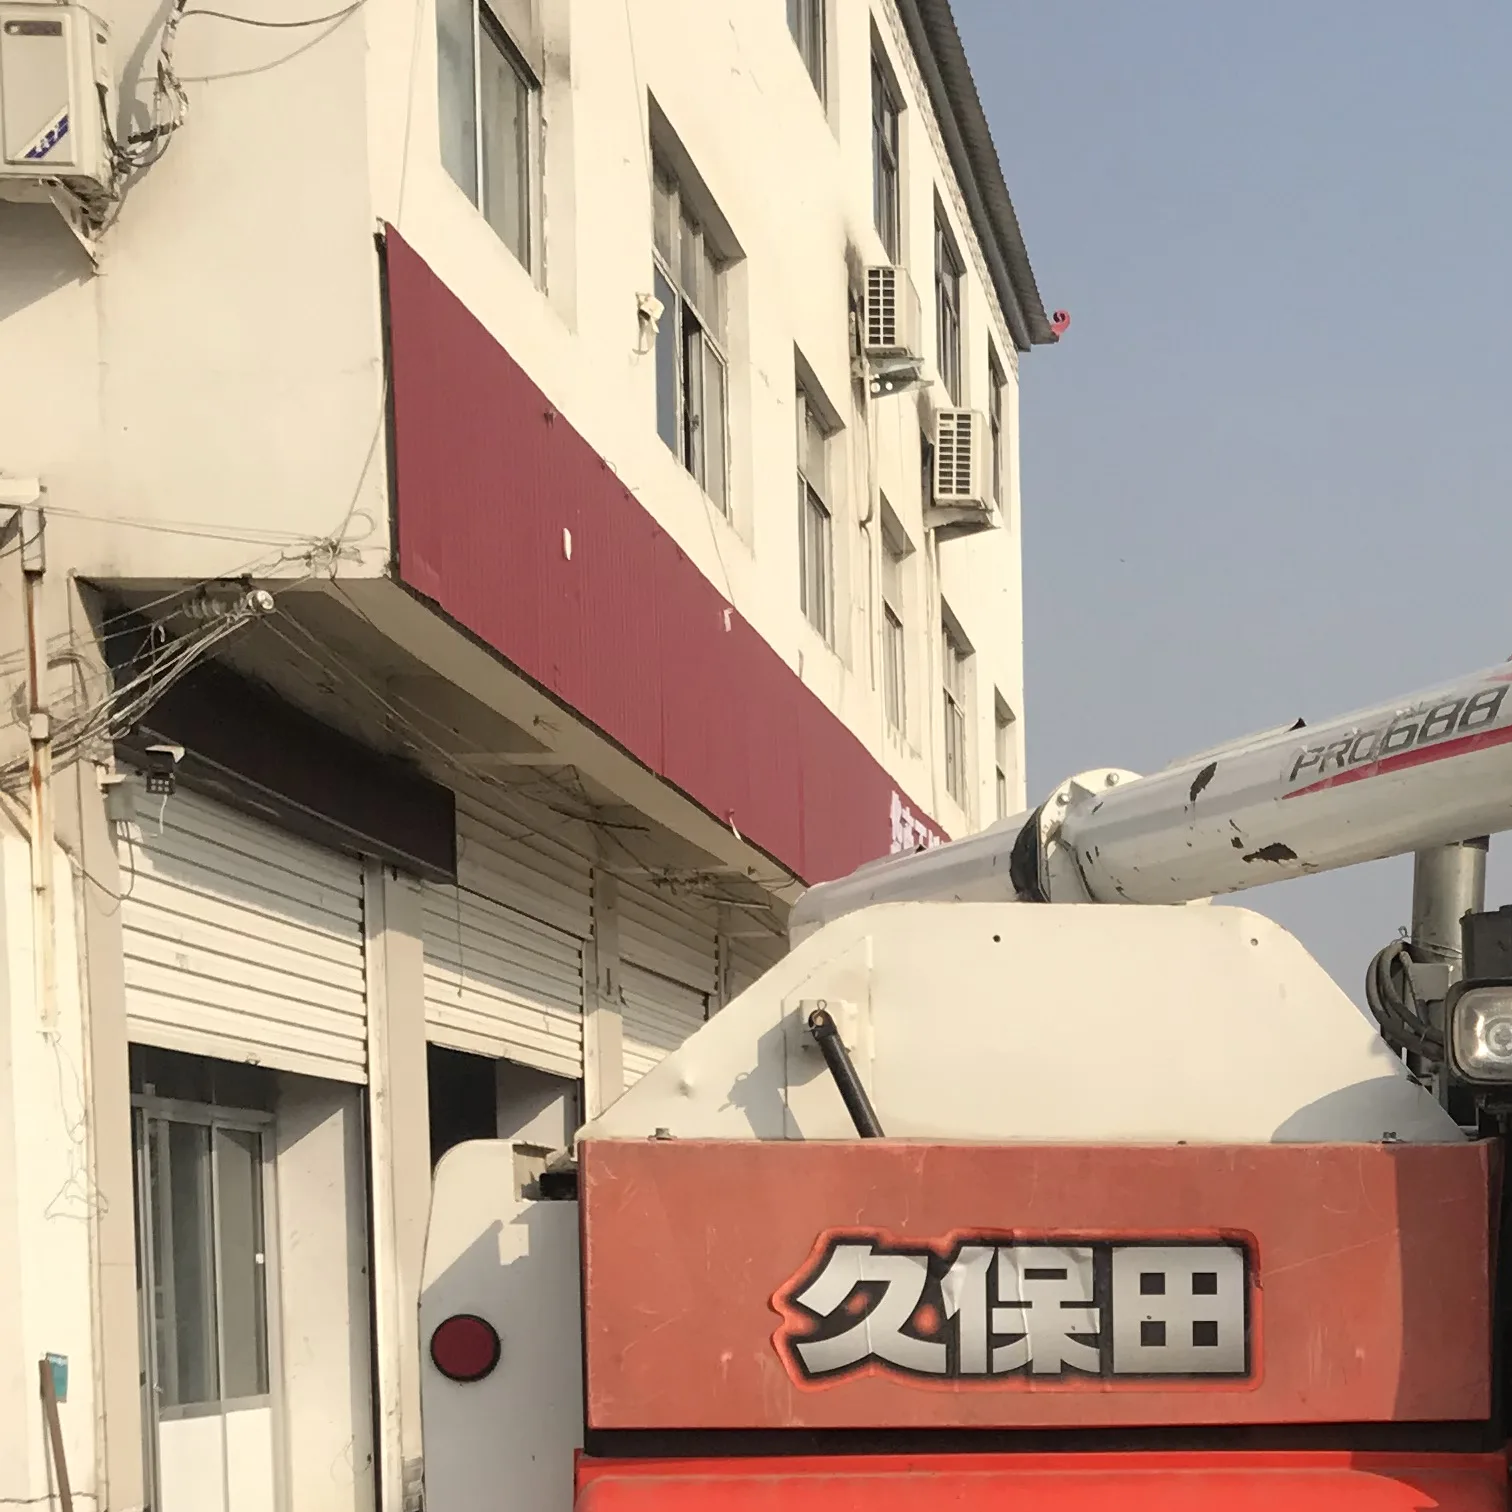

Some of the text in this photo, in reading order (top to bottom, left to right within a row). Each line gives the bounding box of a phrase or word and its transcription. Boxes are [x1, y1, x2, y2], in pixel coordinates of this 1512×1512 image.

[1288, 684, 1511, 782] PRO688
[796, 1244, 1246, 1374] 久保田
